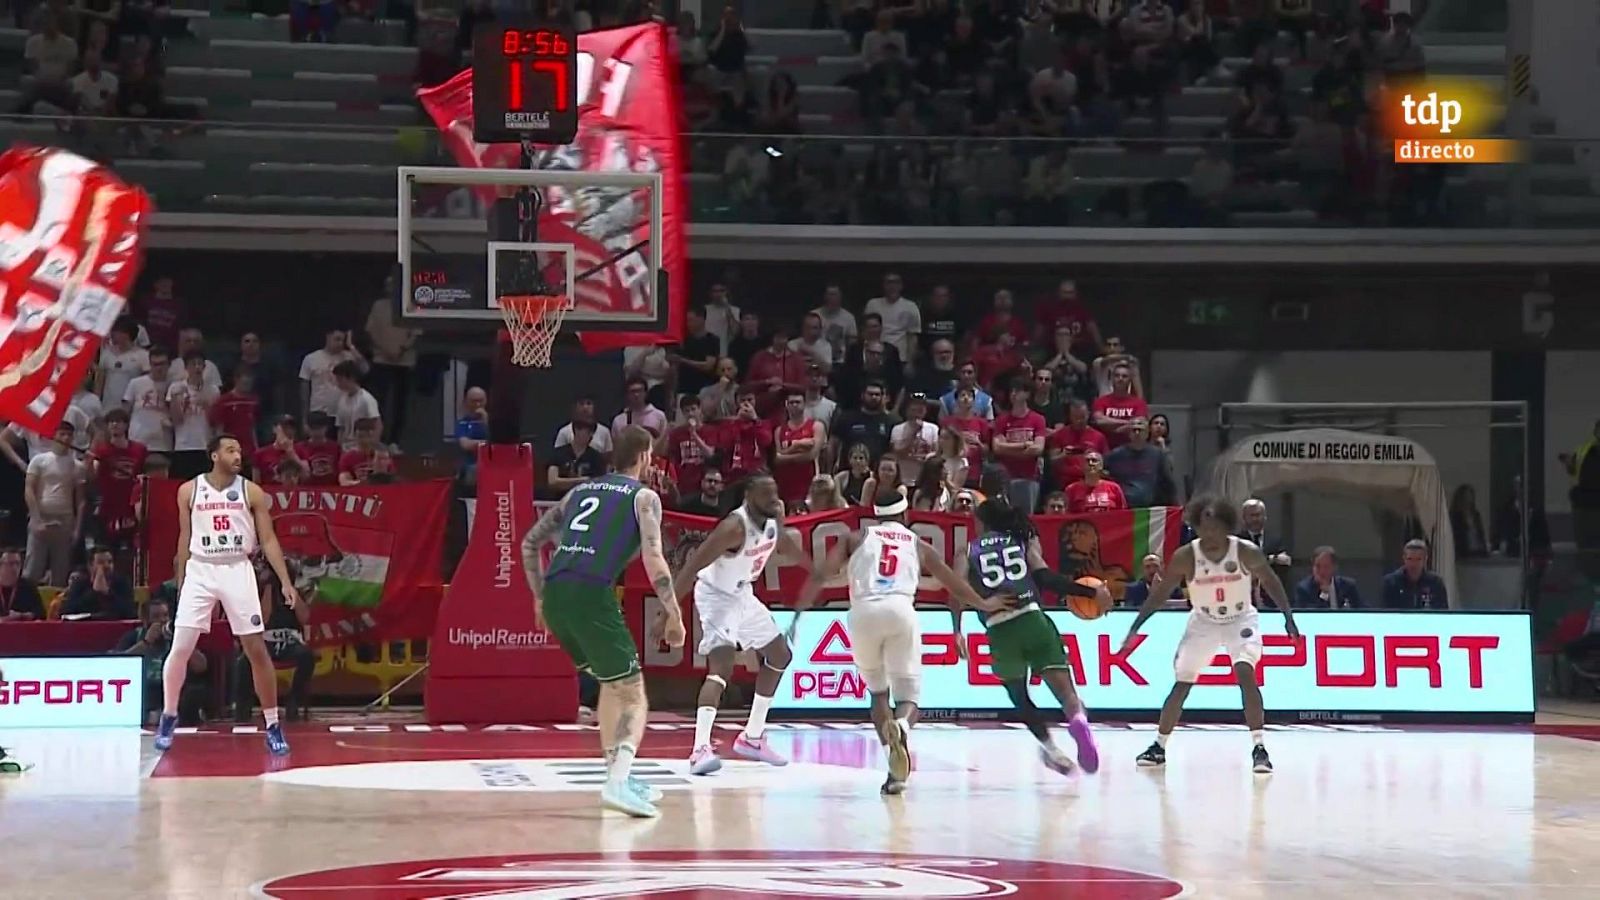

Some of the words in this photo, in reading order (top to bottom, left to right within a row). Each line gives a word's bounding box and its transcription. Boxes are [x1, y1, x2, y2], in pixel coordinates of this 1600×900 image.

[504, 30, 568, 54] 8:56
[510, 61, 568, 110] 17
[1105, 407, 1133, 417] FDNY
[1253, 442, 1305, 458] COMUNE
[1309, 443, 1321, 459] DI
[1325, 443, 1370, 460] REGGIO
[1374, 444, 1415, 460] EMILIA
[213, 514, 231, 531] 55
[570, 496, 600, 531] 2
[494, 492, 516, 587] UnipolRental
[879, 544, 899, 577] 5
[980, 546, 1027, 588] 55
[1216, 588, 1225, 602] 0
[449, 627, 548, 650] UnipolRental
